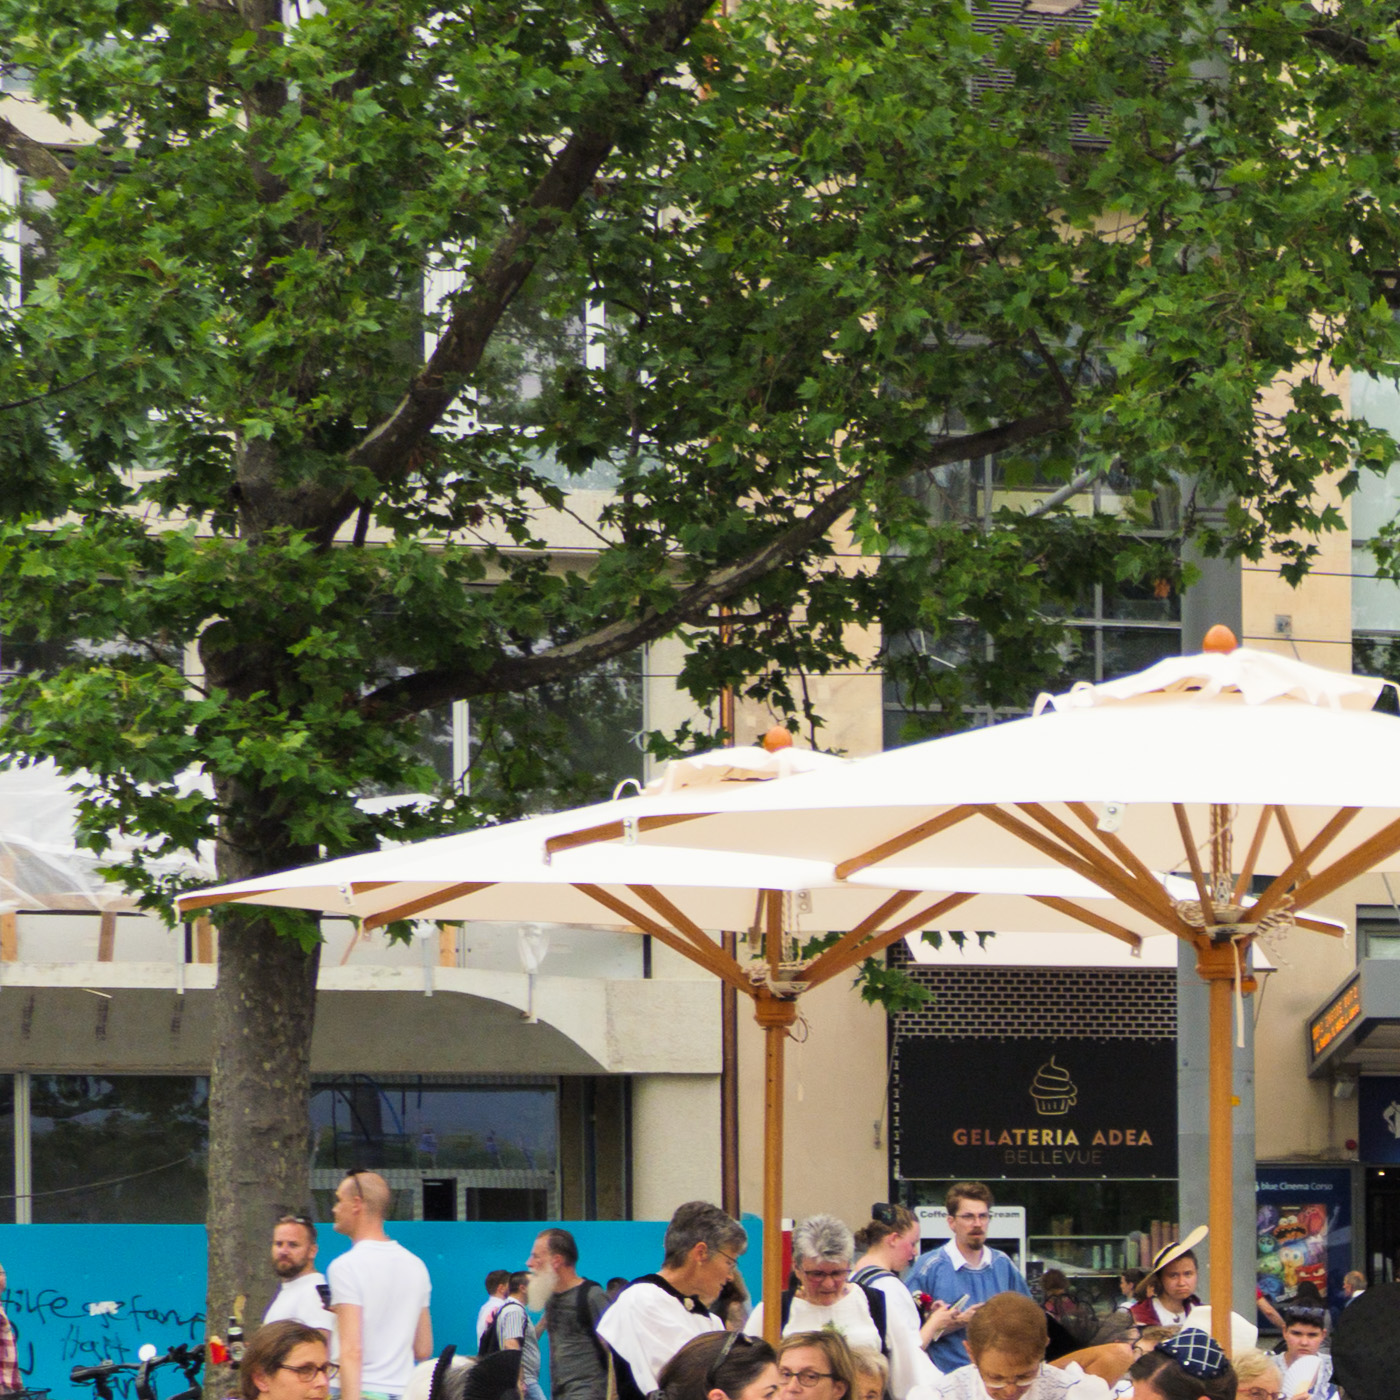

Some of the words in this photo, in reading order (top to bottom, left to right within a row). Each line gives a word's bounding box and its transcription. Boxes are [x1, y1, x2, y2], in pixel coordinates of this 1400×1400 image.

[952, 1128, 1080, 1146] GELATERIA
[1091, 1129, 1153, 1146] ADEA
[1004, 1150, 1102, 1164] BELLEVUE
[1260, 1181, 1279, 1191] blue
[1279, 1181, 1310, 1191] Cinema
[1310, 1182, 1334, 1191] Corso
